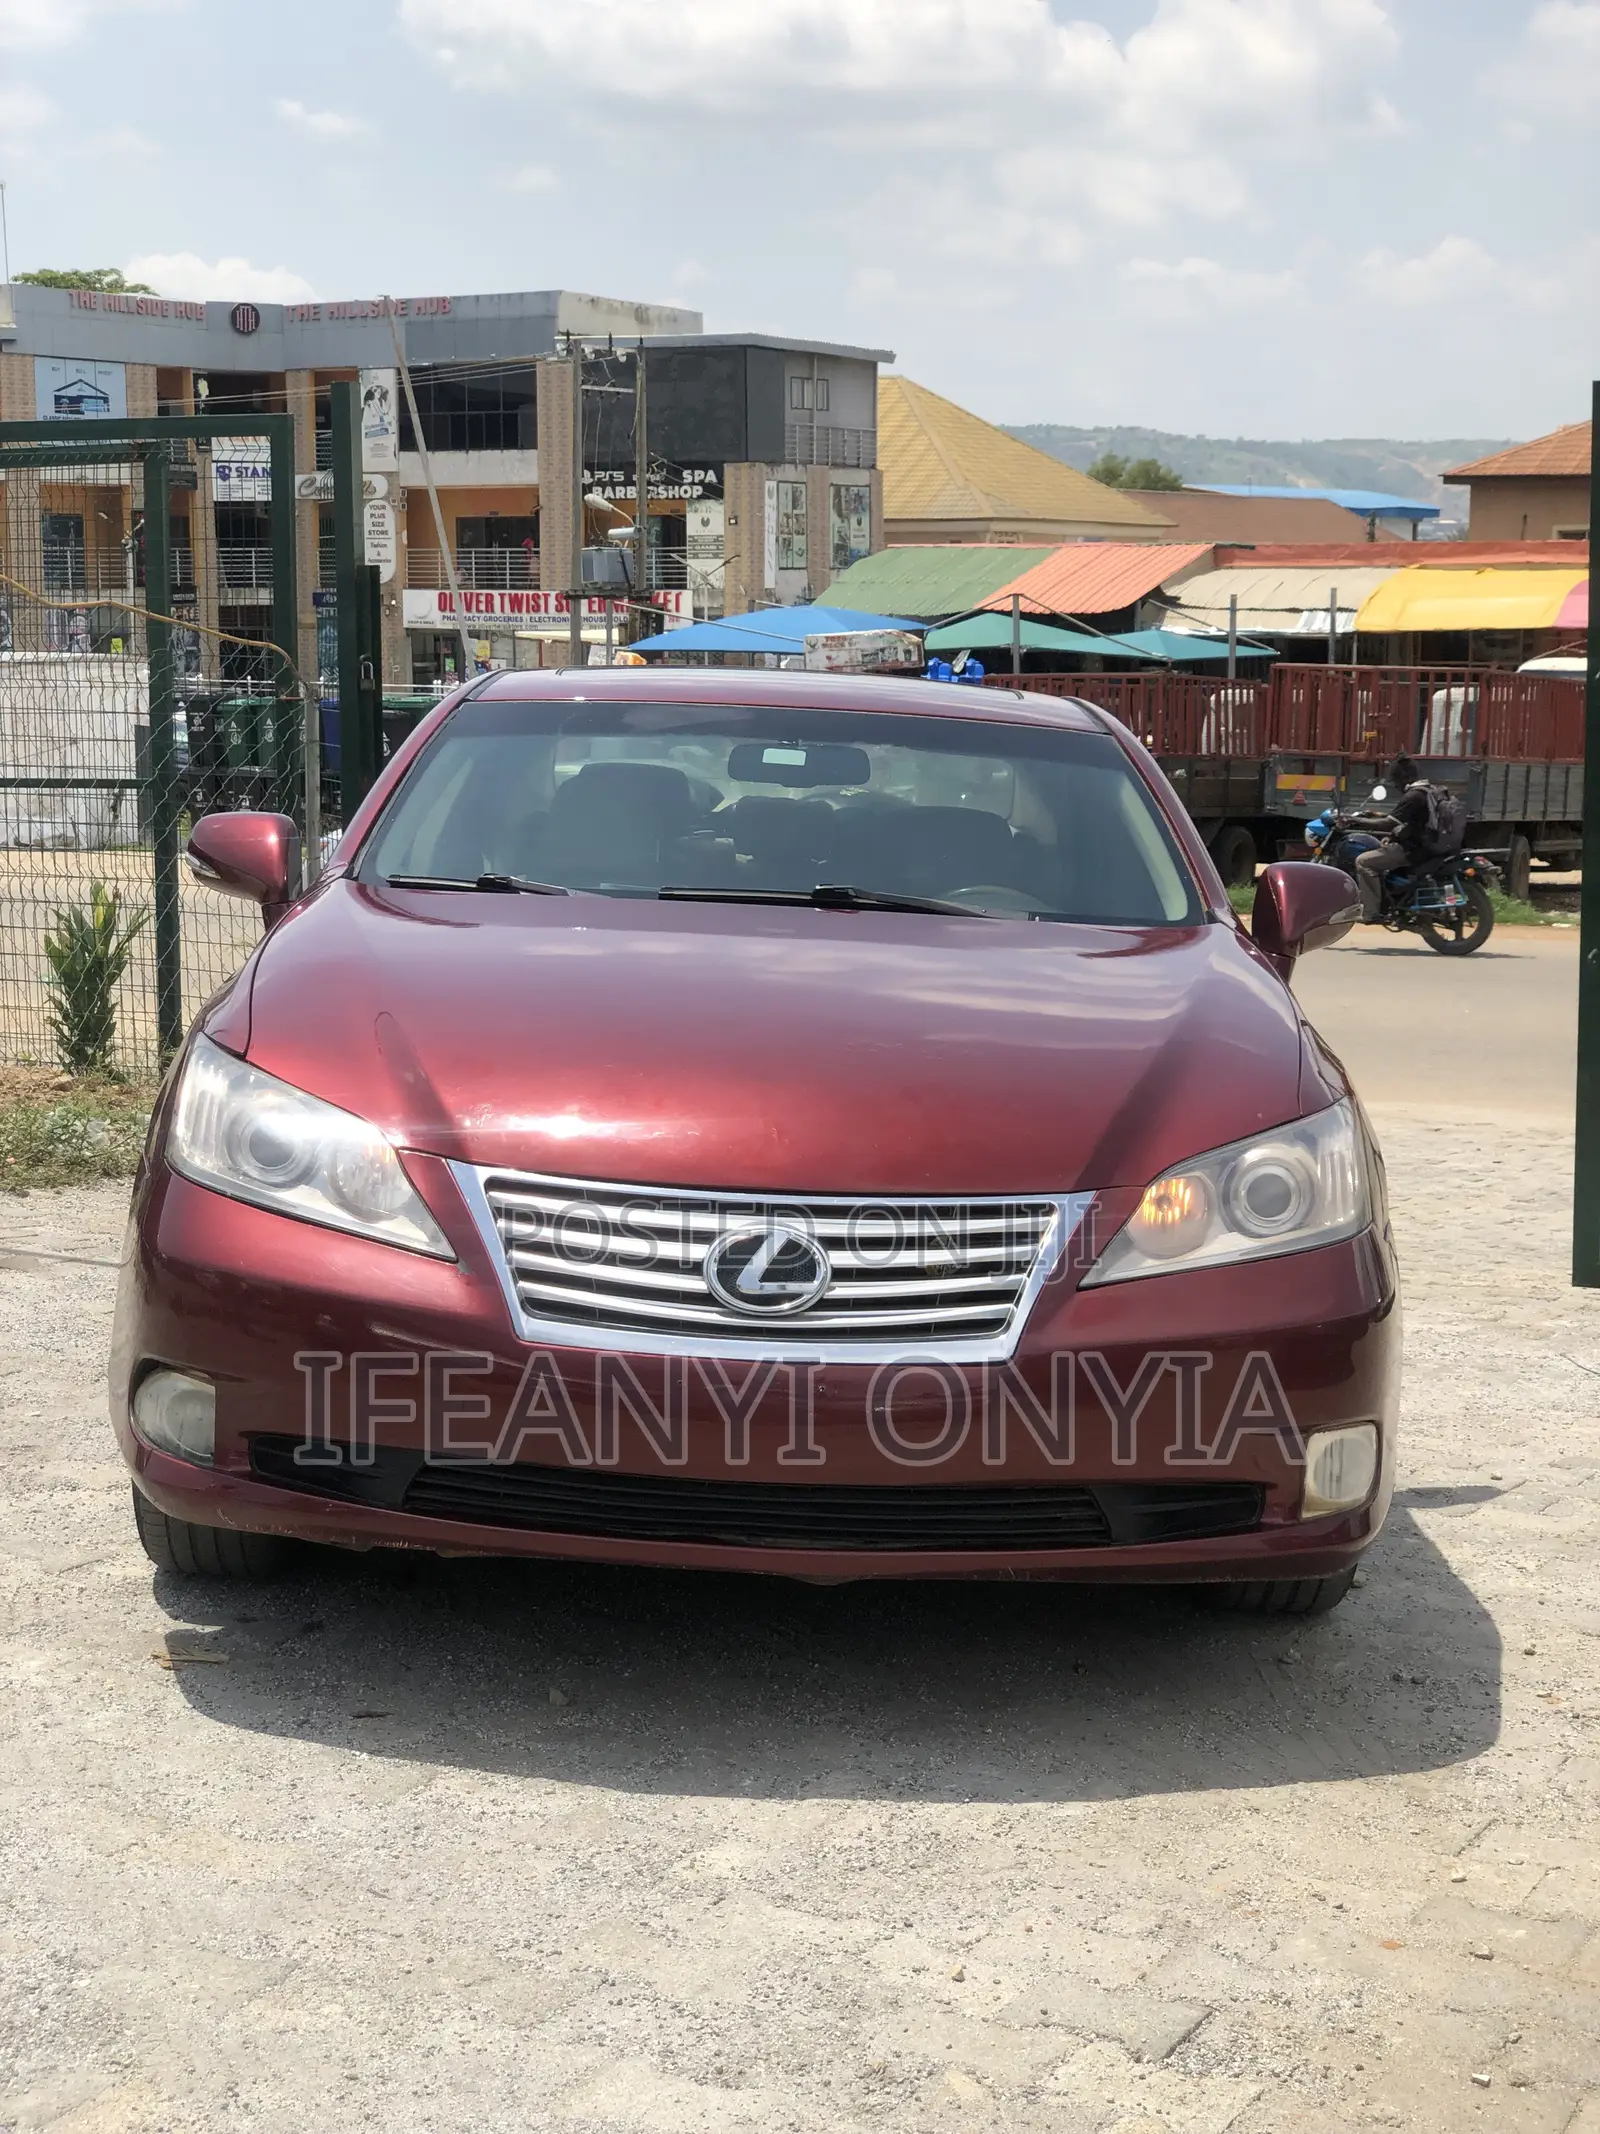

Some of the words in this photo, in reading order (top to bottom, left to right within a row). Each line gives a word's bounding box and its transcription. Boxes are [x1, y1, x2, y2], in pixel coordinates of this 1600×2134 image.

[69, 290, 98, 310] THE
[103, 294, 168, 317] HILLSIDE
[175, 301, 205, 321] HUB
[287, 304, 321, 322] THE
[415, 296, 450, 316] HUB
[682, 469, 718, 483] SPA
[592, 485, 703, 499] BARBRSHOP
[438, 592, 495, 613] OLVER
[498, 593, 551, 614] TWIST
